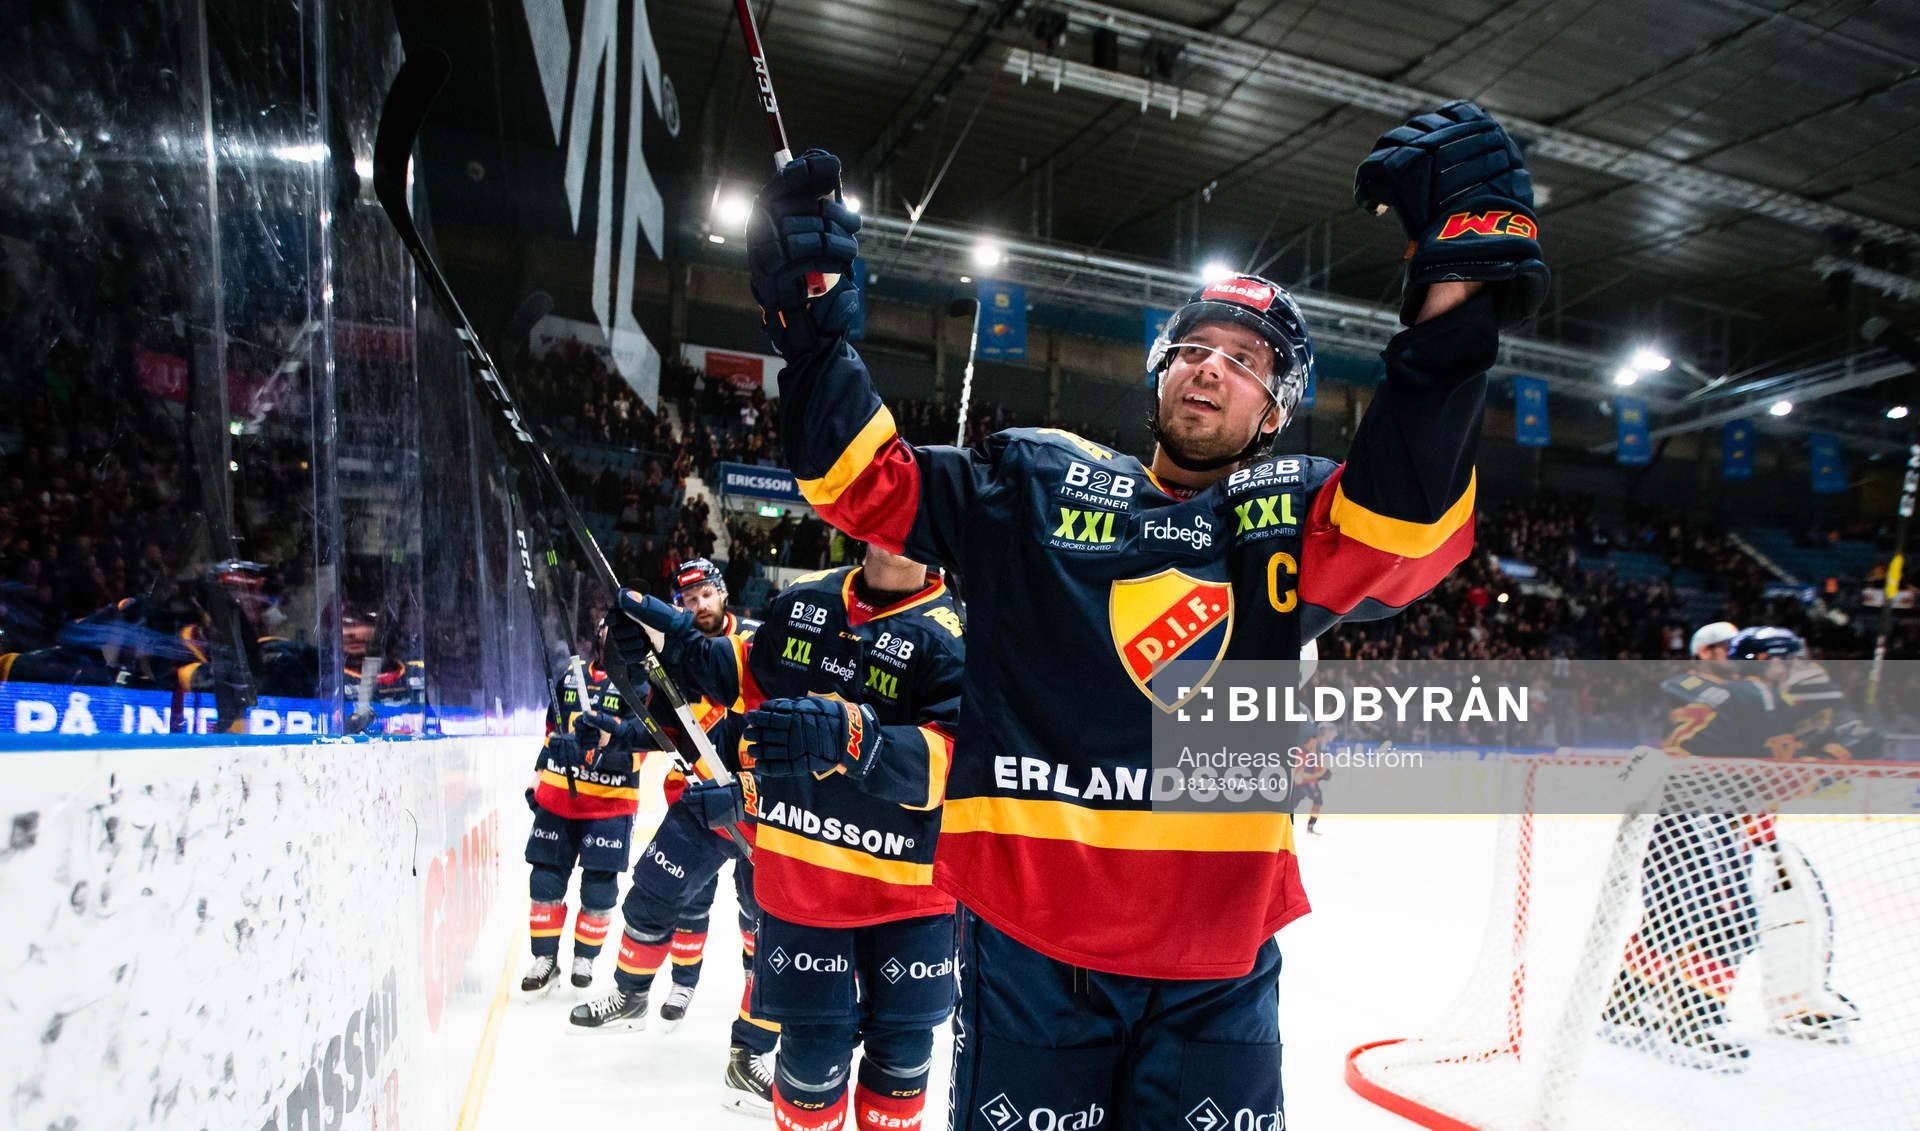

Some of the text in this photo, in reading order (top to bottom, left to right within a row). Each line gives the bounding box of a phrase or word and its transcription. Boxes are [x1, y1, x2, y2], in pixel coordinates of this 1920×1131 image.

[752, 56, 777, 113] CCM
[727, 473, 792, 493] ERICSSON
[1064, 461, 1136, 499] B2B
[1227, 459, 1301, 487] B2B
[1227, 475, 1300, 497] IT-PARTNER
[1060, 486, 1130, 511] IT-PARTNER
[1052, 507, 1117, 544] XXL
[1234, 493, 1298, 537] XXL
[1050, 539, 1062, 547] ALL
[1061, 542, 1086, 551] SPORTS
[1144, 517, 1213, 551] Fabege
[516, 529, 536, 590] CCM
[1267, 551, 1298, 613] C
[790, 601, 829, 626] B2B
[788, 620, 823, 635] IT-PARTNER
[1135, 595, 1221, 665] D.I.F.
[782, 636, 813, 666] XXL
[870, 649, 908, 671] IT-PARTNER
[874, 632, 916, 661] B2B
[820, 656, 855, 683] Fabege
[864, 665, 899, 700] XXL
[14, 691, 99, 735] PÅ
[602, 695, 619, 709] XXL
[534, 828, 559, 842] Ocab
[595, 837, 623, 850] Ocab
[654, 850, 686, 880] Ocab
[794, 952, 849, 973] Ocab
[909, 957, 953, 980] Ocab
[793, 1099, 825, 1109] CCM
[891, 1087, 921, 1097] CCM
[1028, 1103, 1105, 1131] Ocab
